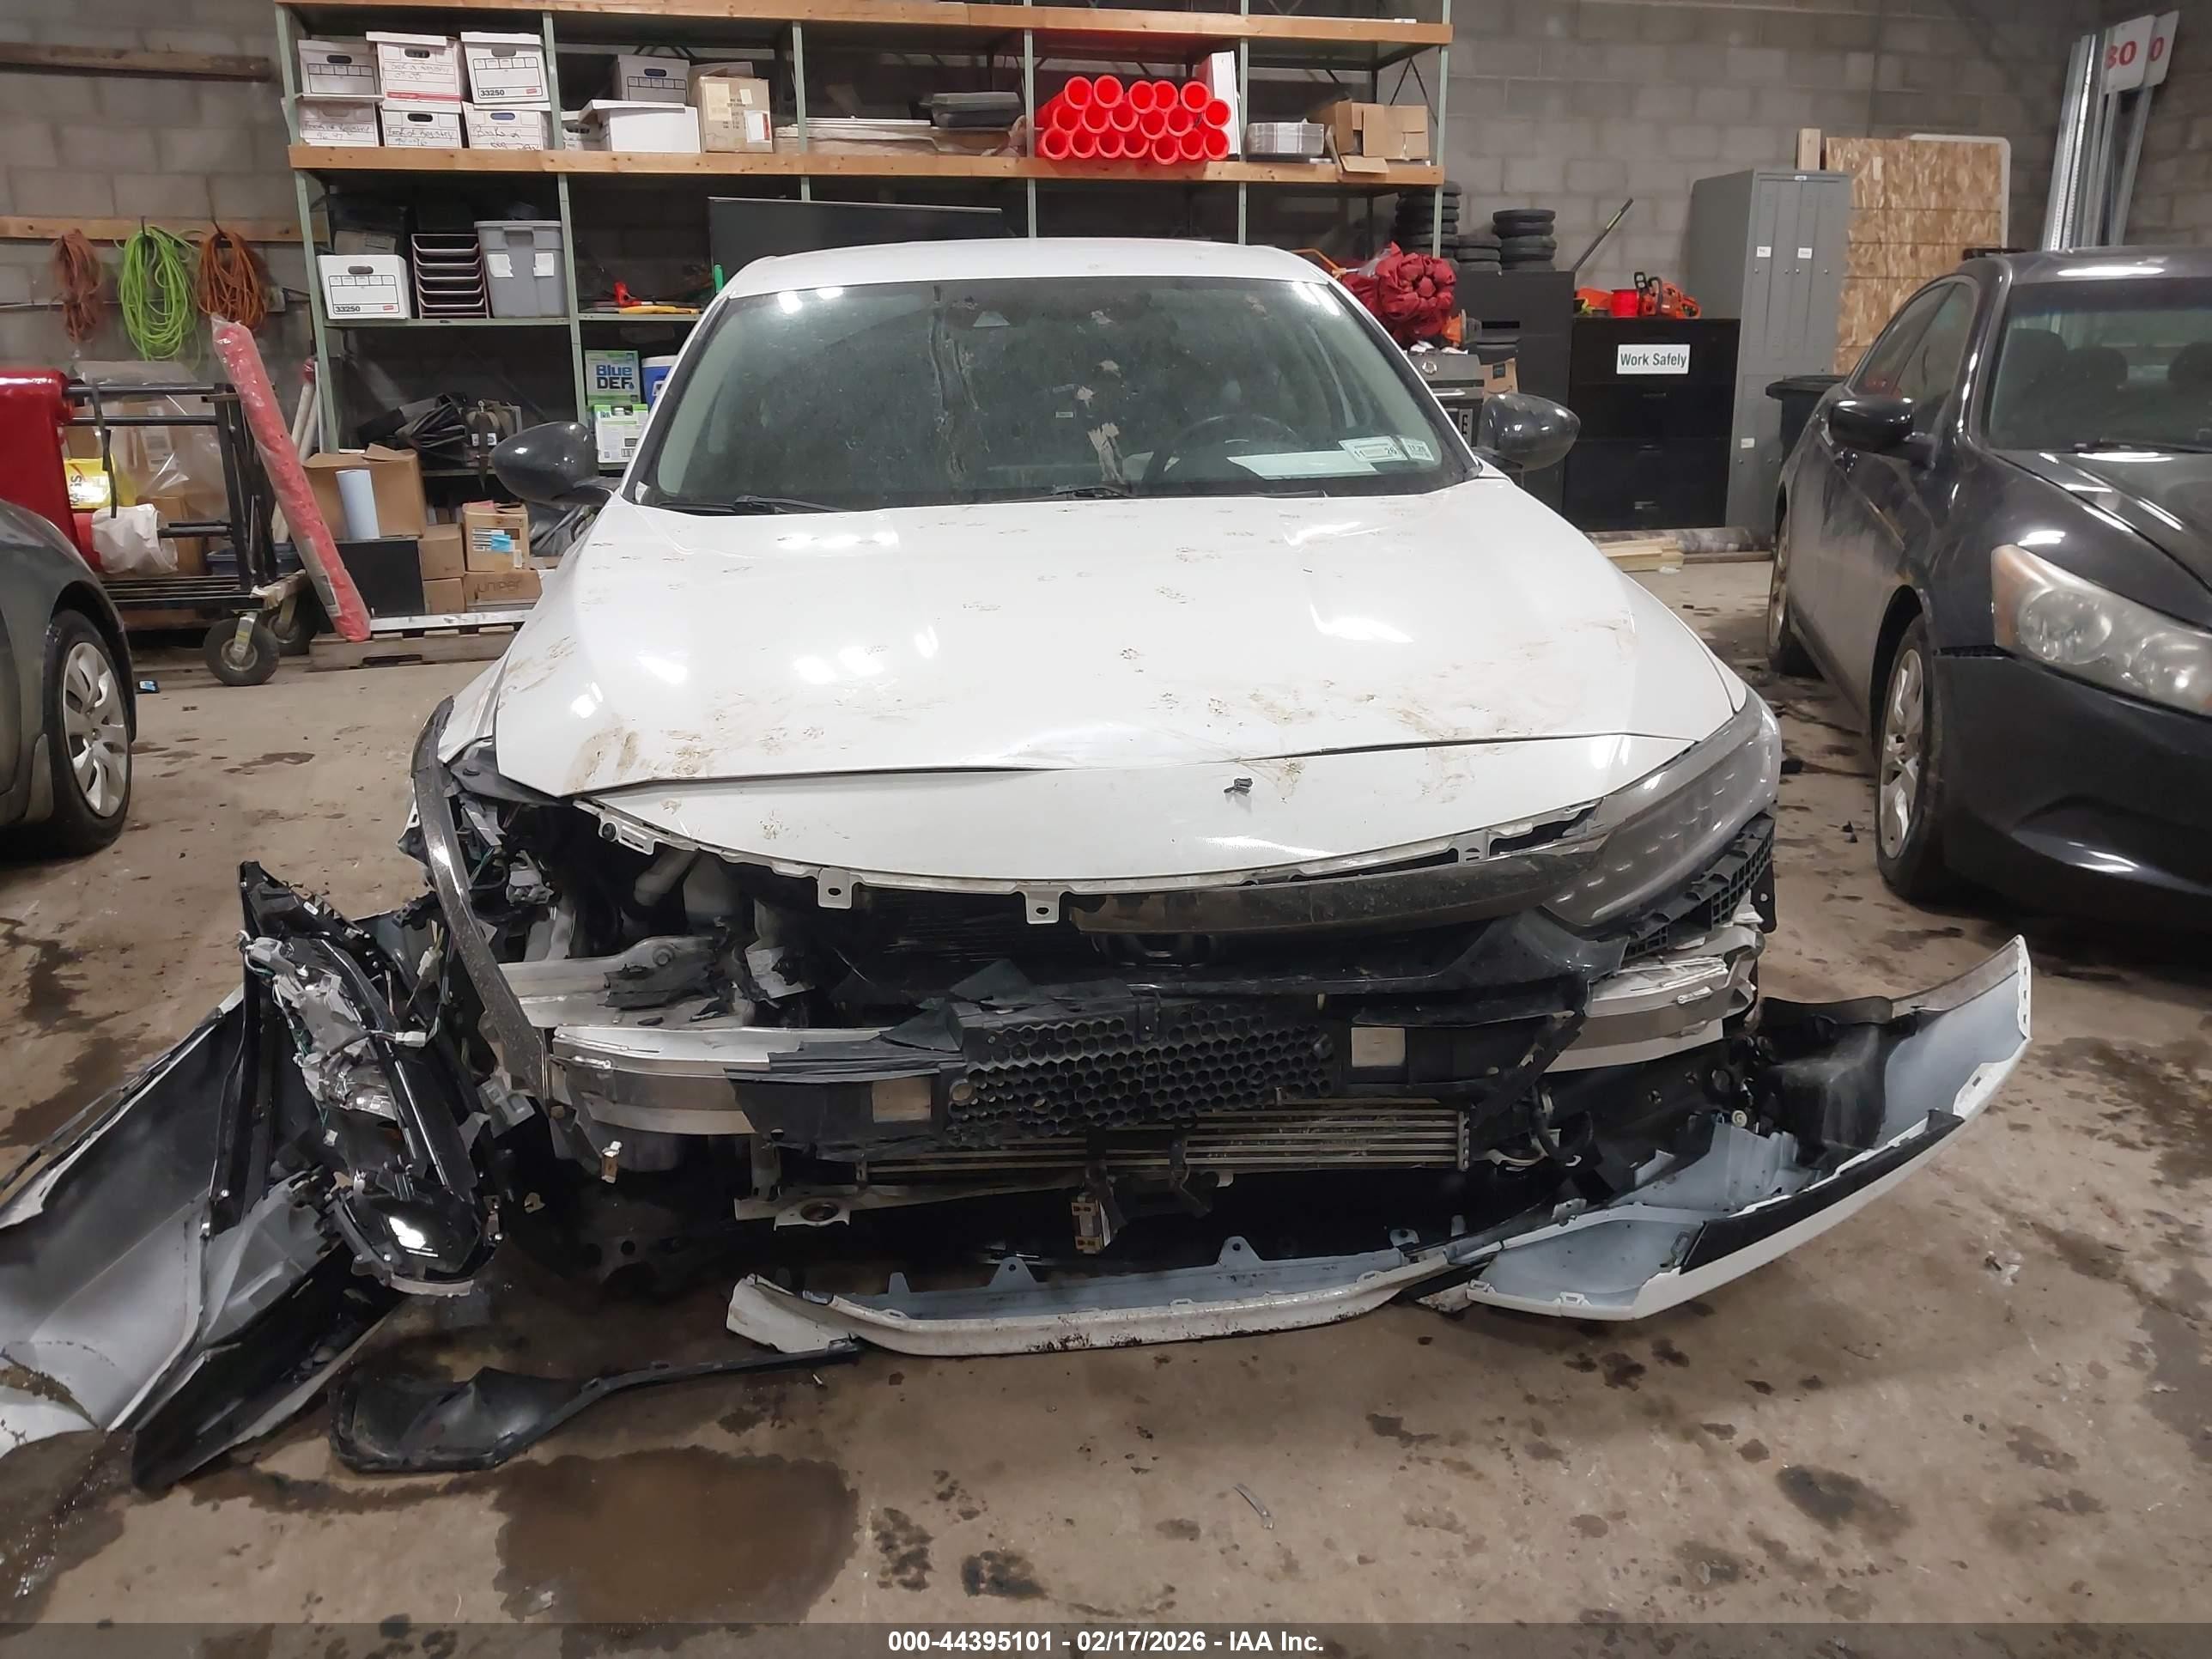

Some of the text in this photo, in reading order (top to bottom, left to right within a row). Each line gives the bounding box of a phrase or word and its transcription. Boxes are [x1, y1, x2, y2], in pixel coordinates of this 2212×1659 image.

[1620, 352, 1686, 368] Work Safely
[596, 364, 632, 376] Blue
[597, 377, 632, 389] DEF
